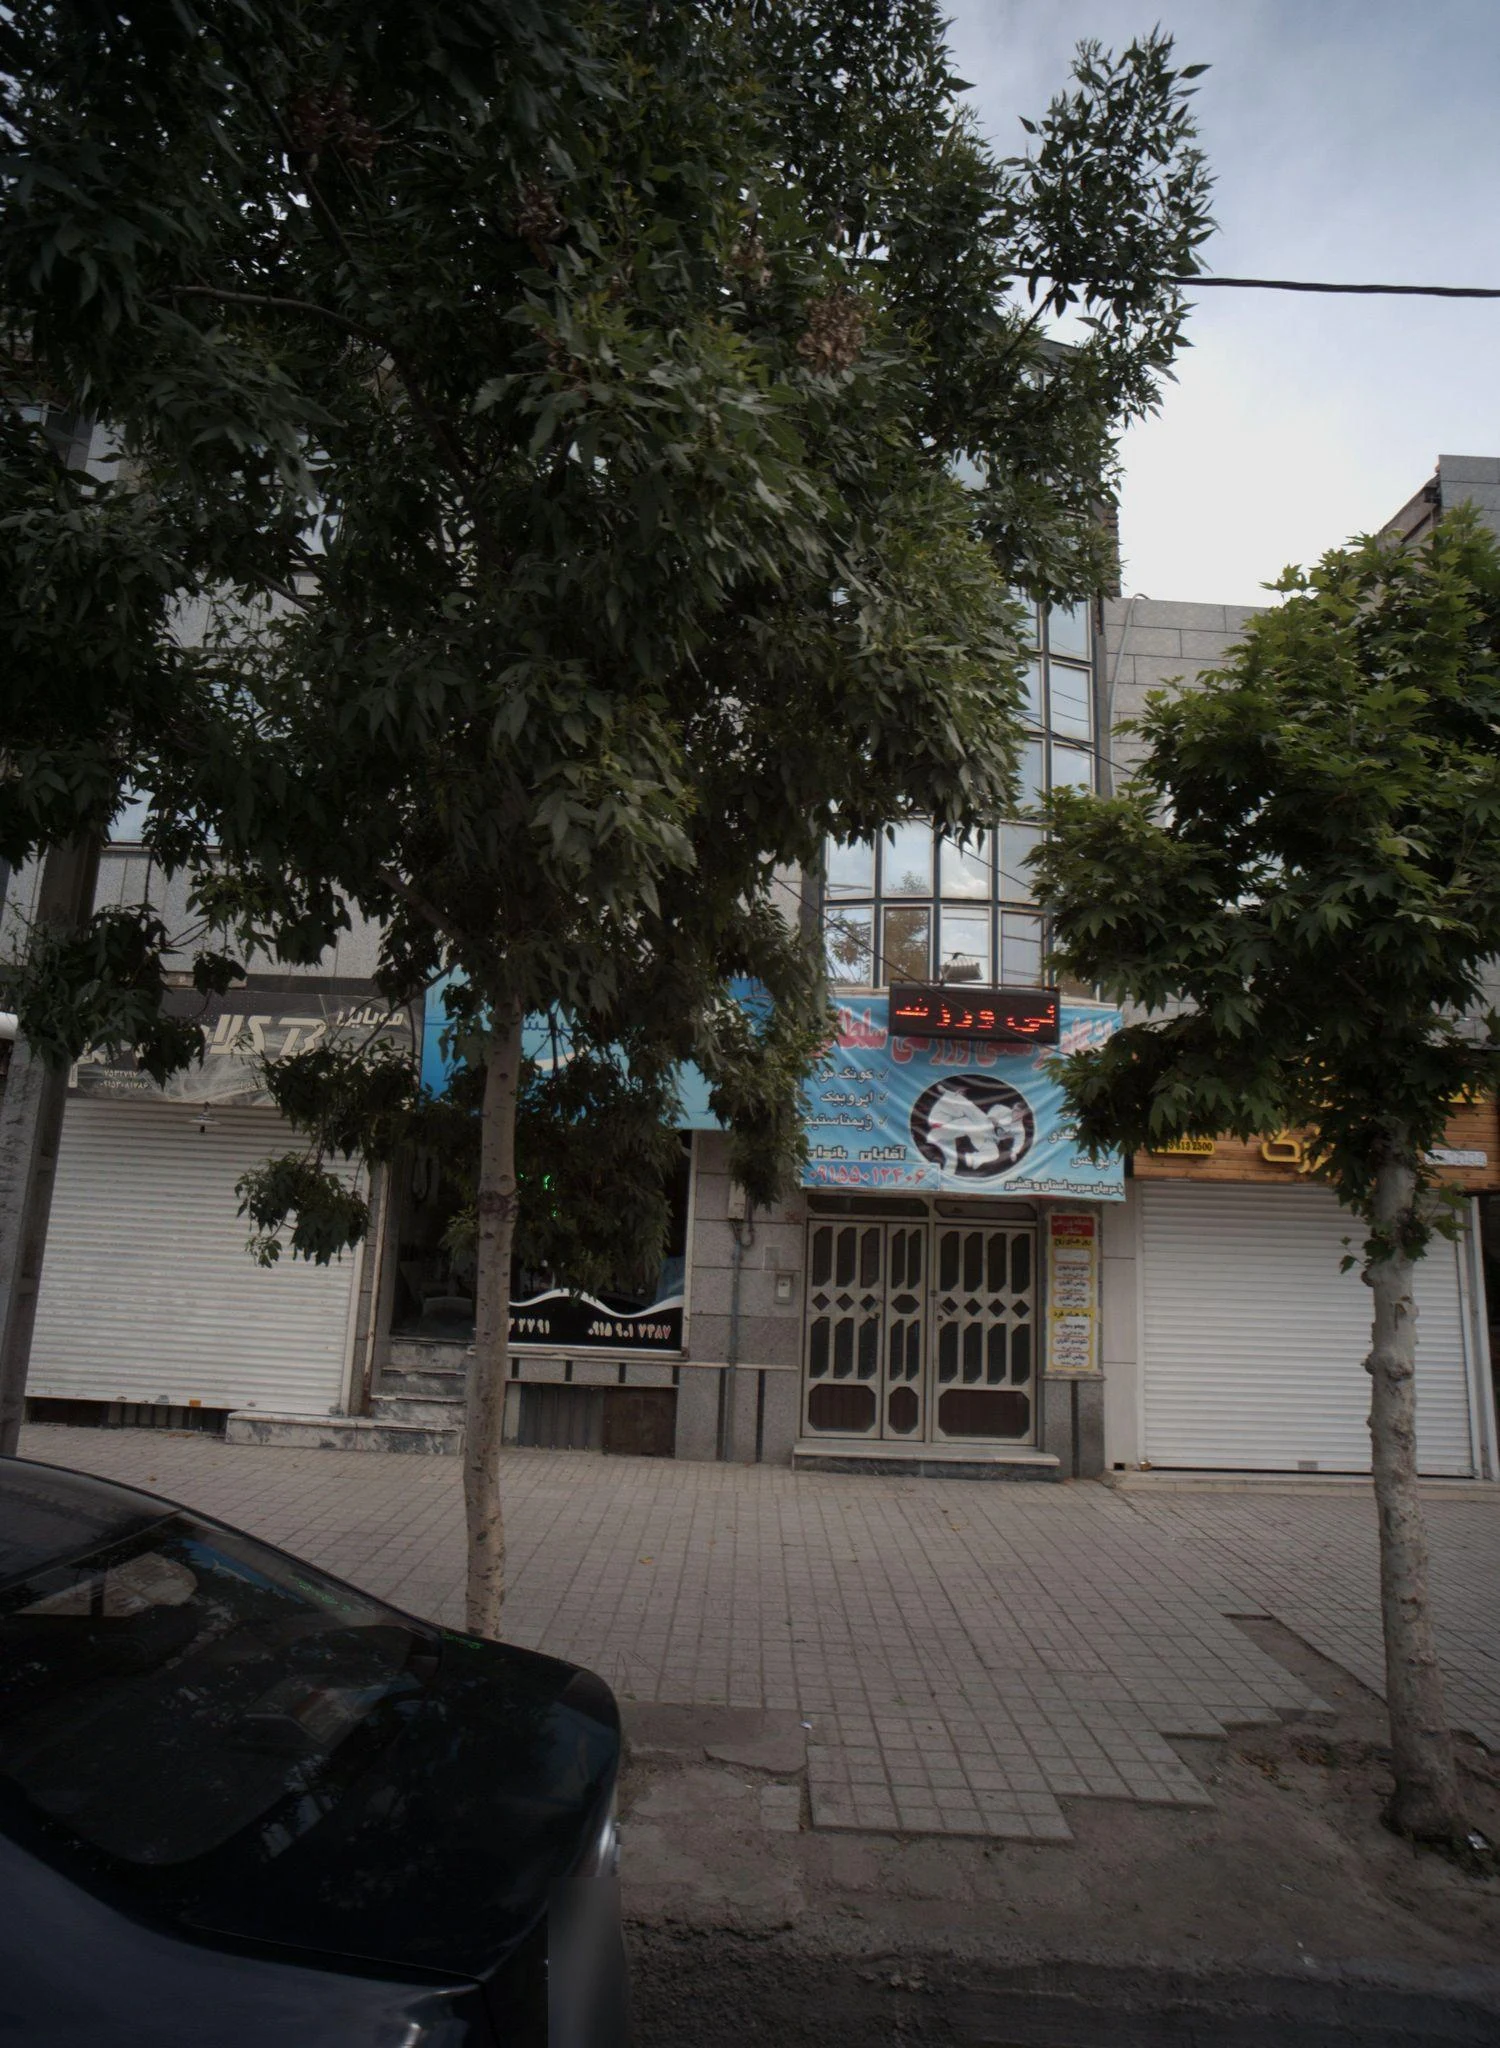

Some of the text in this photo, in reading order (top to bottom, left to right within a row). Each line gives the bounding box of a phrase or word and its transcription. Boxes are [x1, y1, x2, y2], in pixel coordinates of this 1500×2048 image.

[337, 1006, 405, 1030] موبایل
[859, 1145, 906, 1161] آقایان
[1005, 1177, 1033, 1191] کشور
[1041, 1178, 1068, 1192] استان
[588, 1320, 612, 1337] ۰۹۱۵
[616, 1322, 634, 1338] ۹۰۱
